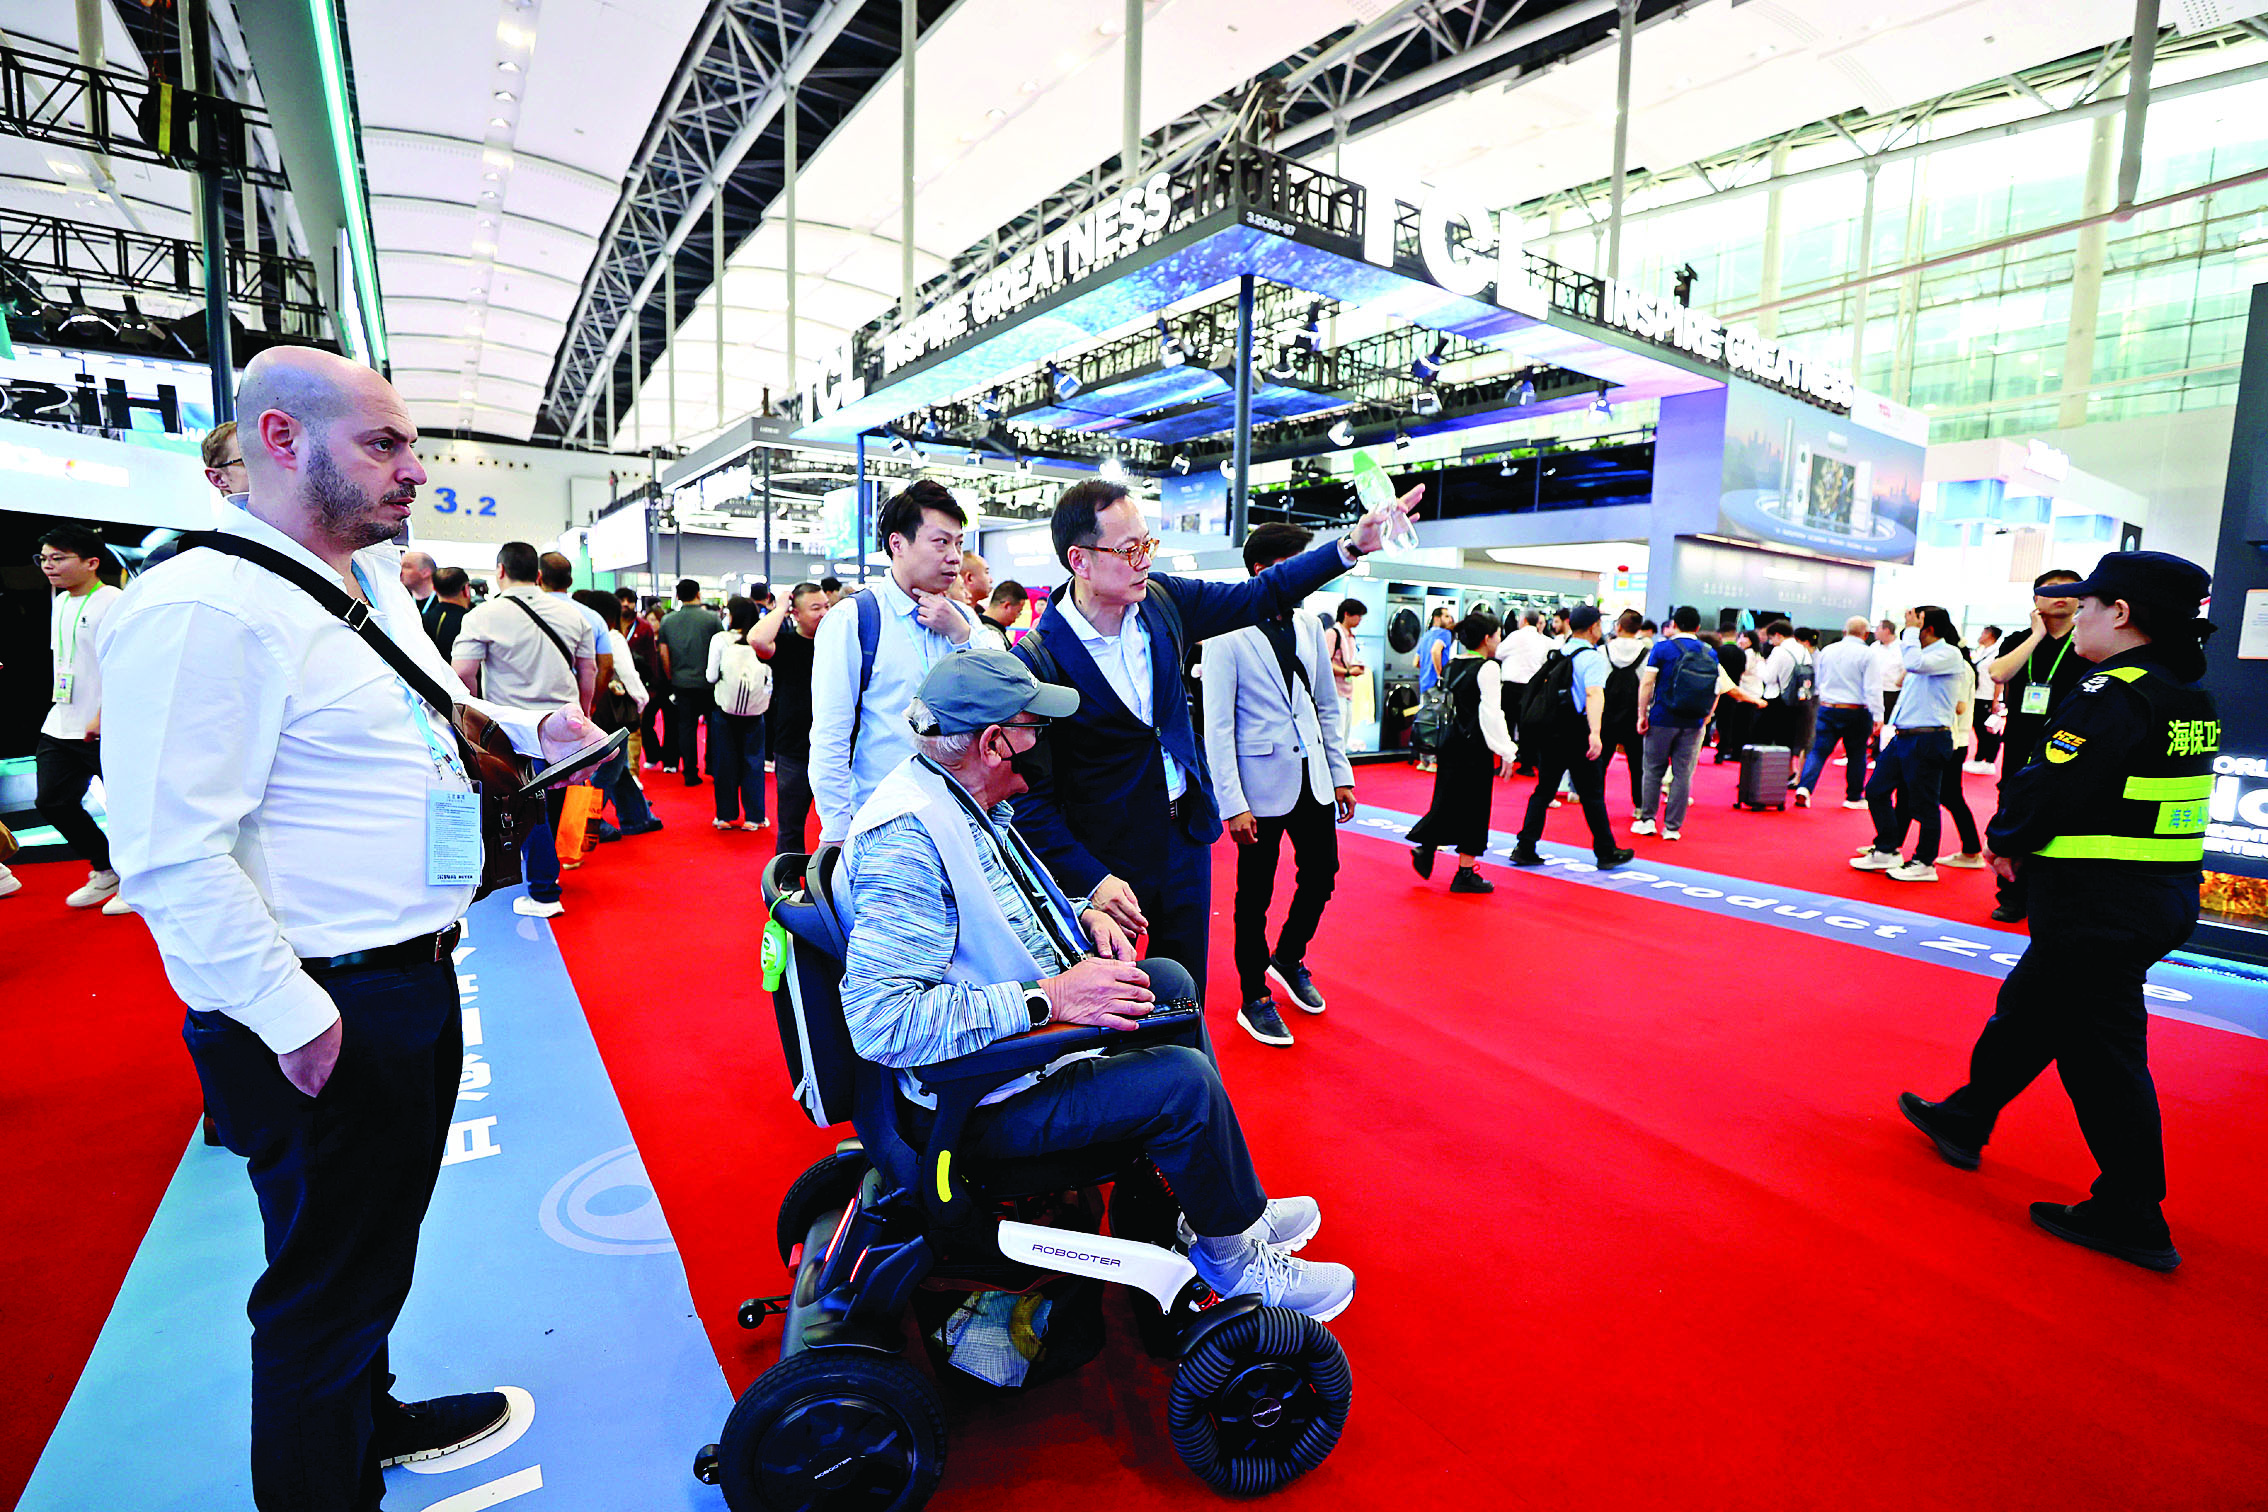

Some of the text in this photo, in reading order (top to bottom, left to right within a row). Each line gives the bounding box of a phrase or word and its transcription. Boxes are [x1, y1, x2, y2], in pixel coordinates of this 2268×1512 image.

[800, 171, 1172, 427] TCL INSPIRE GREATNESS
[1339, 143, 1854, 409] TCL INSPIRE GREATNESS
[433, 486, 498, 518] 3.2
[1607, 870, 1908, 940] Product
[1031, 1244, 1122, 1268] ROBOOTER
